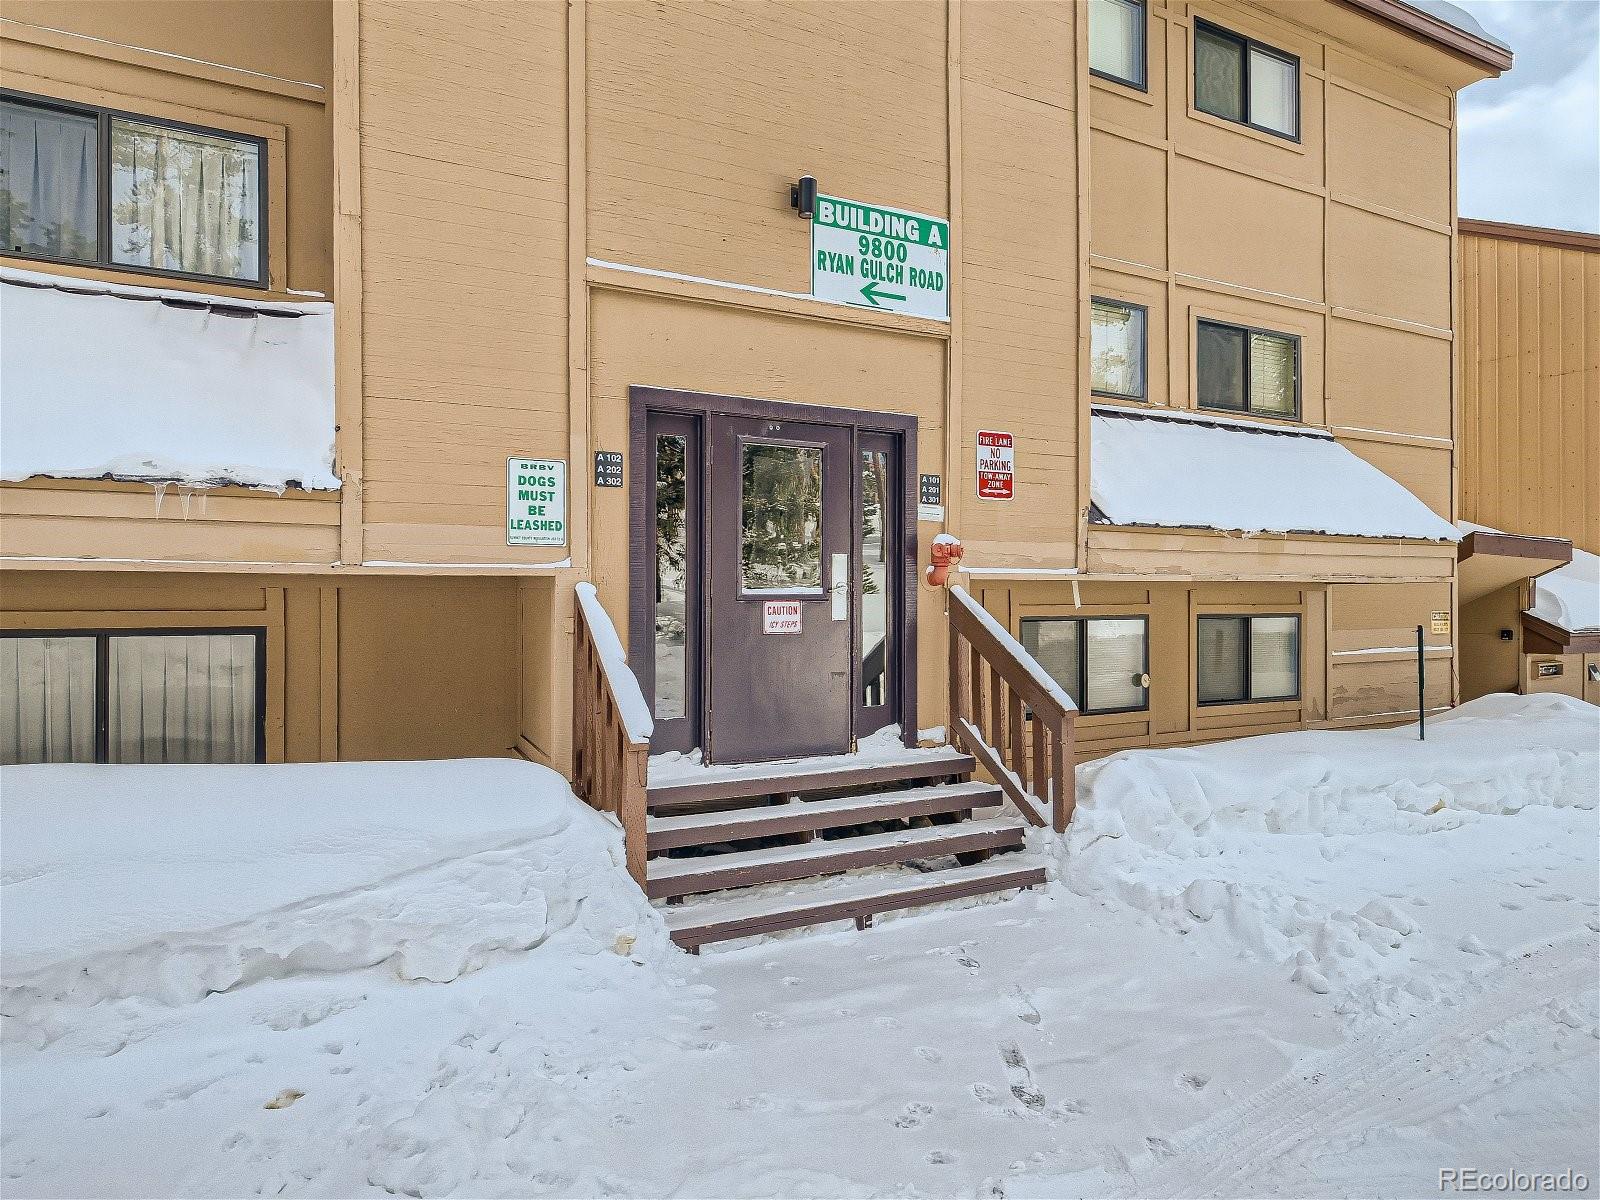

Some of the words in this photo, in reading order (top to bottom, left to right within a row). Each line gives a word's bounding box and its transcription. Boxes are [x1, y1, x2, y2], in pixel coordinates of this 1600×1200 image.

[820, 200, 920, 242] BUILDING
[928, 224, 942, 246] A
[858, 234, 908, 264] 9800
[818, 250, 854, 276] RYAN
[860, 258, 904, 284] GULCH
[910, 266, 944, 292] ROAD
[980, 436, 994, 444] FIRE
[996, 438, 1012, 446] LANE
[606, 454, 622, 462] 102
[990, 448, 1000, 458] NO
[606, 466, 622, 474] 202
[980, 458, 1010, 472] PARKING
[518, 476, 556, 486] DOGS
[598, 476, 604, 484] A
[606, 478, 622, 486] 302
[980, 472, 1010, 480] TOW-AWAY
[988, 480, 1004, 488] ZONE
[518, 490, 556, 502] MUST
[528, 506, 546, 516] BE
[510, 518, 562, 532] LEASHED
[768, 606, 798, 616] CAUTION
[770, 620, 778, 628] ICY
[780, 620, 798, 628] STEPS
